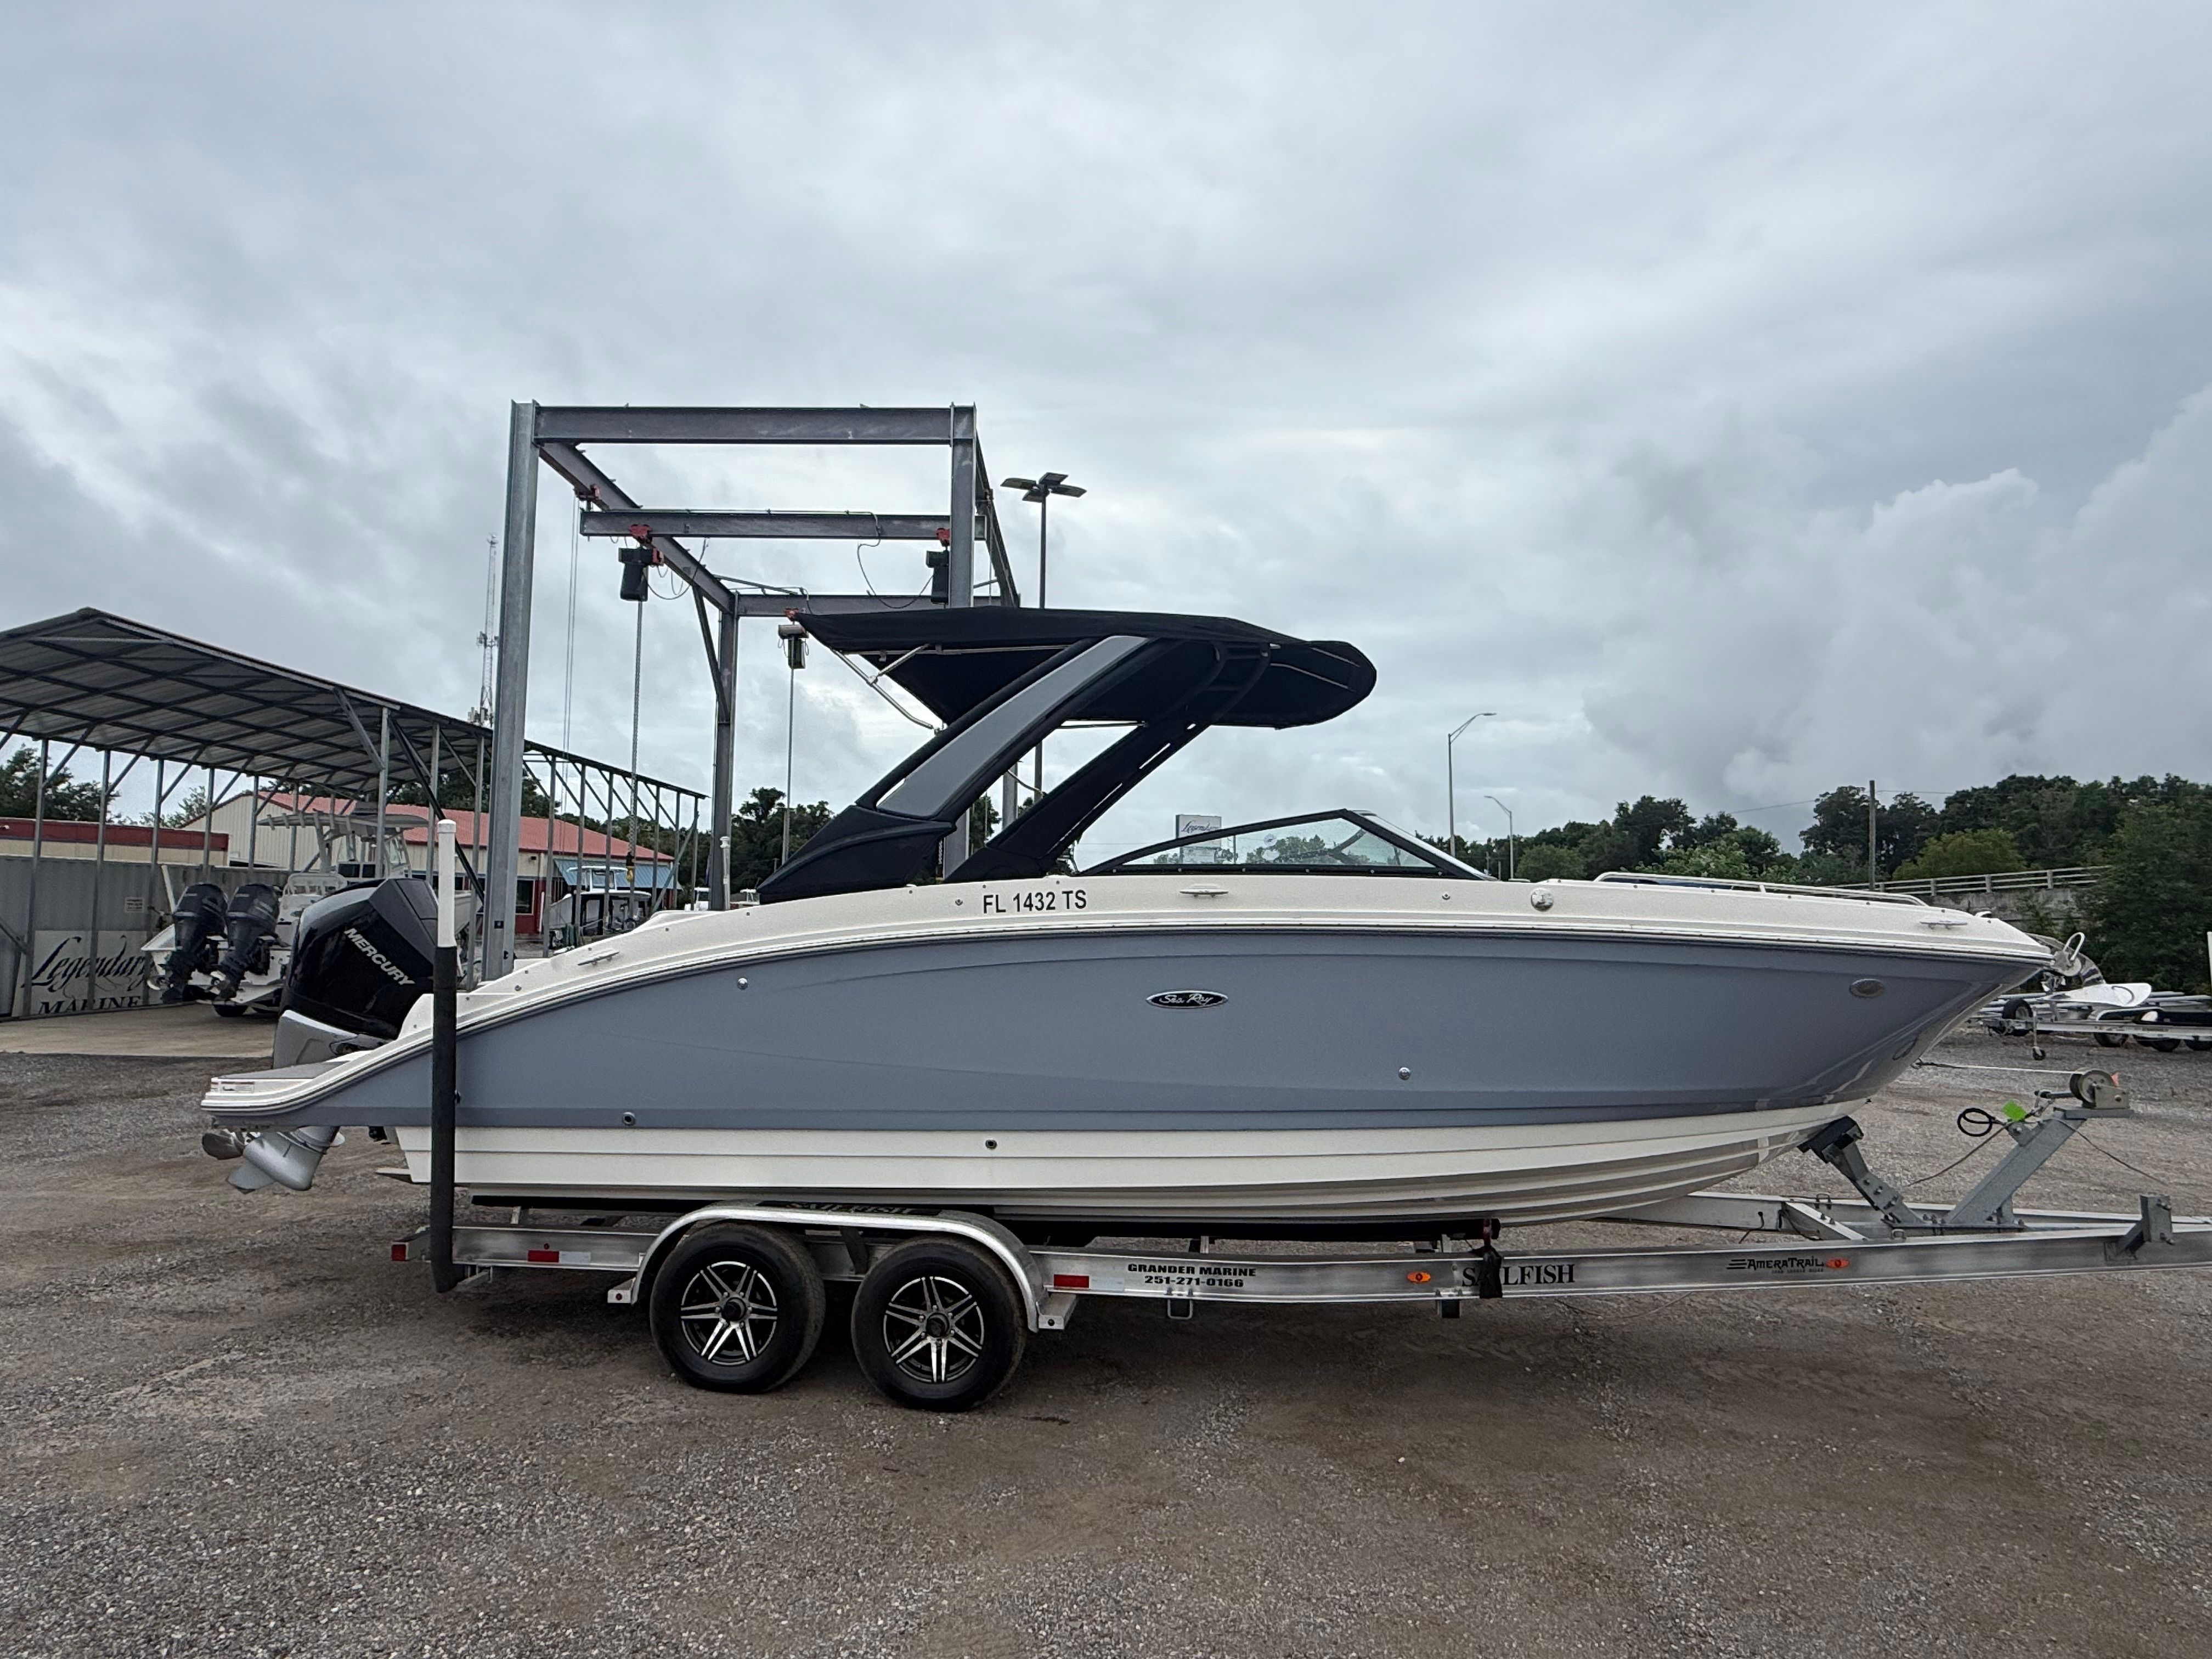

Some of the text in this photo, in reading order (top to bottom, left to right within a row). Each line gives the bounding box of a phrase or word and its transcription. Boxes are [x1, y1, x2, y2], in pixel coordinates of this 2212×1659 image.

[983, 889, 1087, 913] FL 1432 TS
[343, 928, 415, 985] MERCURY
[1159, 993, 1214, 1006] Sea Ray
[1128, 1263, 1256, 1276] GRANDER MARINE
[1462, 1263, 1576, 1287] SLFISH
